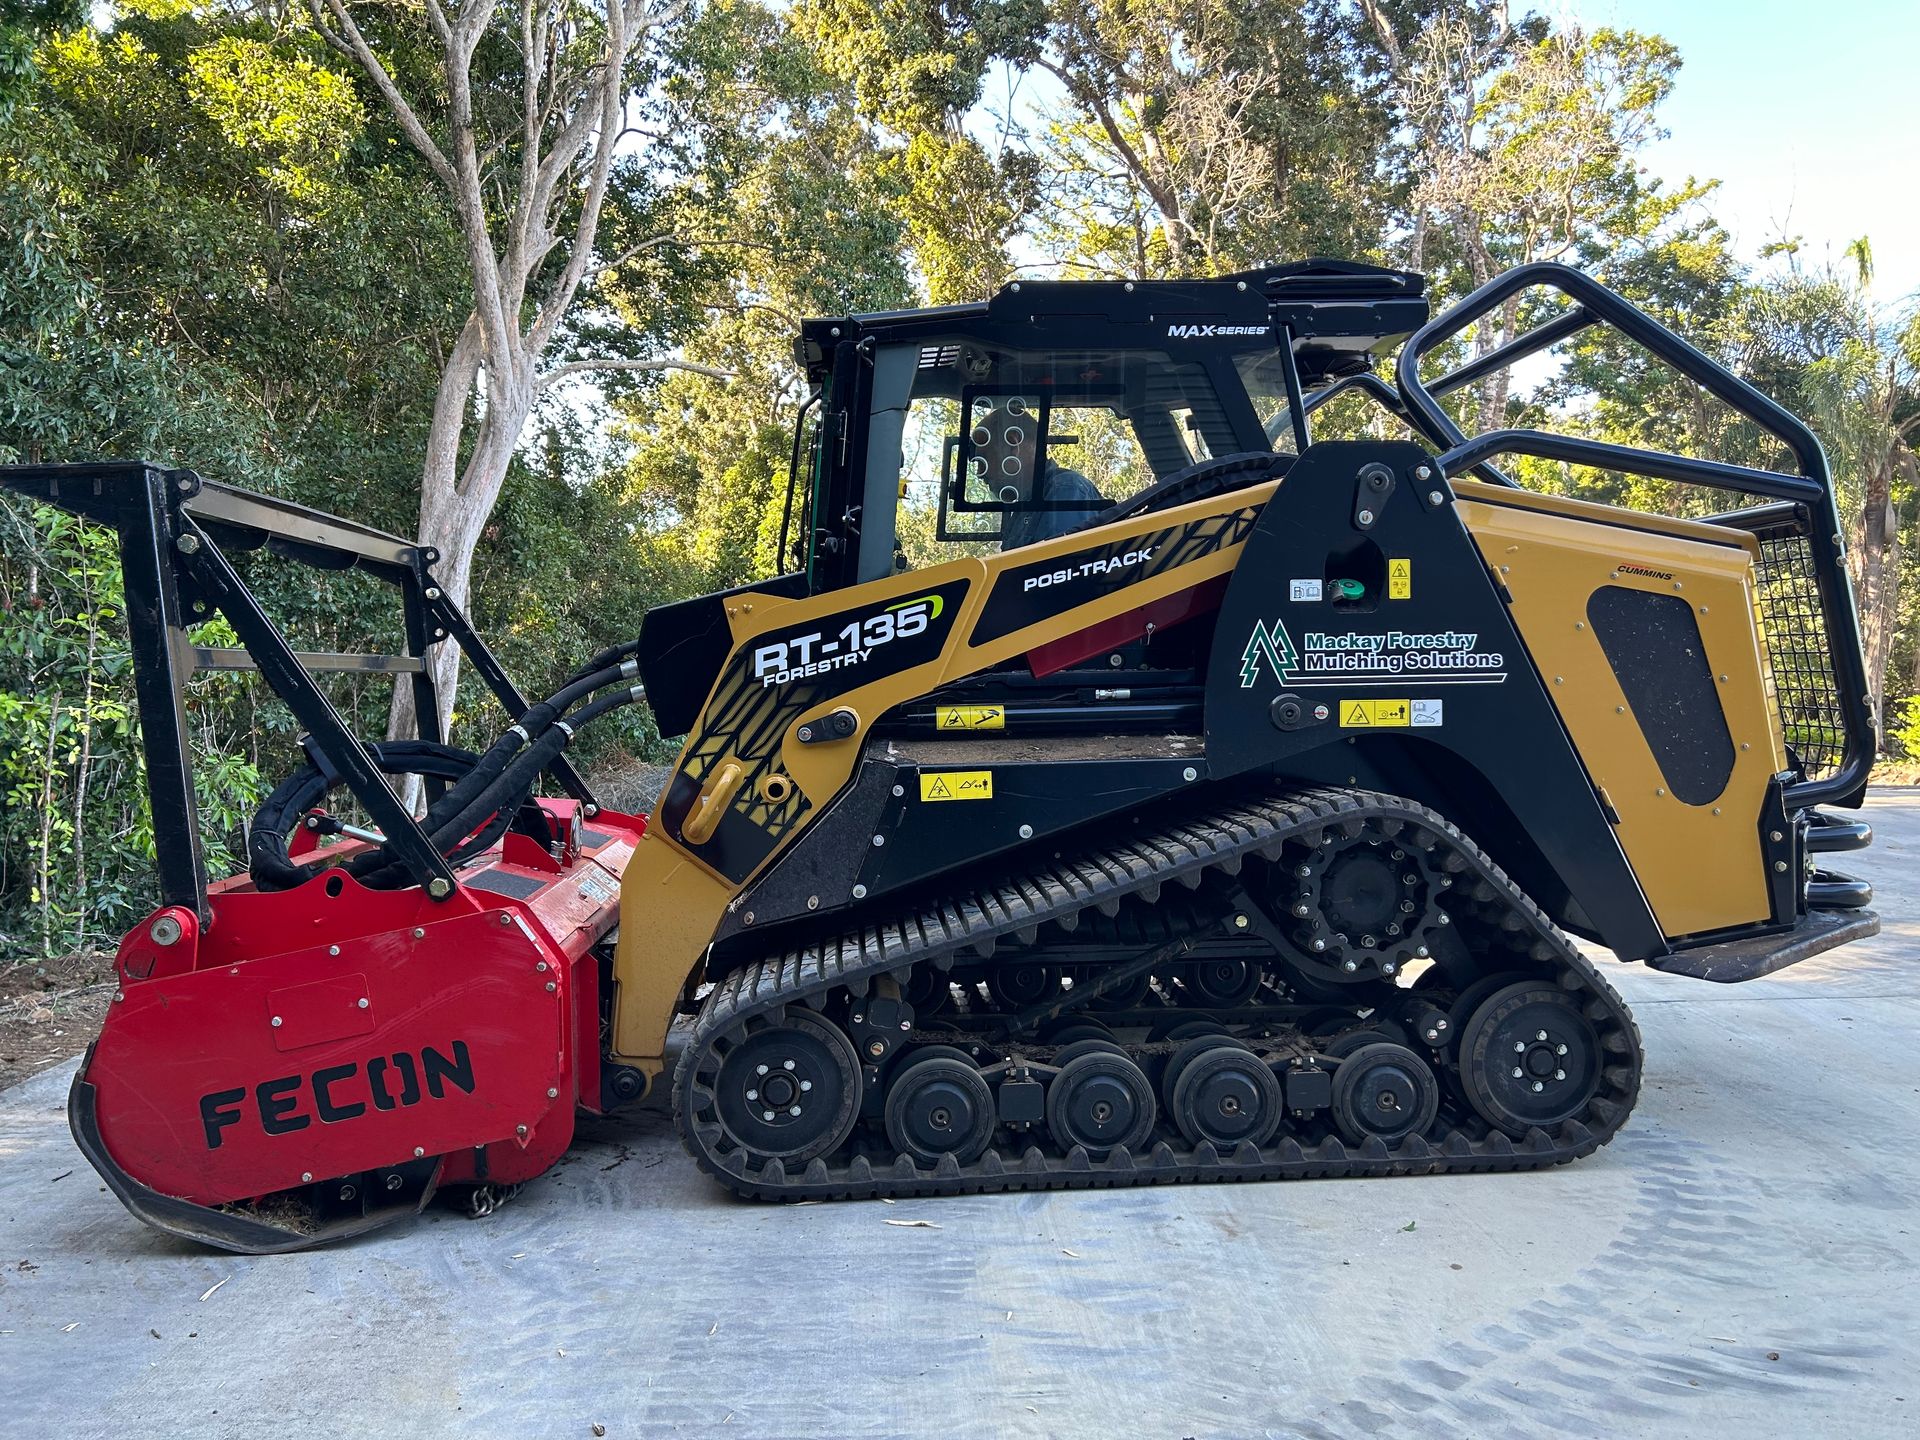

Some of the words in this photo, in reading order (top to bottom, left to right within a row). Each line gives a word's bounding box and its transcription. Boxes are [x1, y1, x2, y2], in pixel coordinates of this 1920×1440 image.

[1167, 325, 1267, 339] MAX-SERIES
[1024, 547, 1153, 592] POSI-TRACK
[1617, 565, 1673, 581] CUMMINS
[755, 603, 928, 678] RT-135
[1304, 632, 1386, 652] Mackay
[1387, 631, 1478, 651] Forestry
[763, 648, 873, 688] FORESTRY
[1304, 652, 1402, 672] Mulching
[1404, 651, 1504, 669] Solutions
[199, 1040, 477, 1151] FECON
